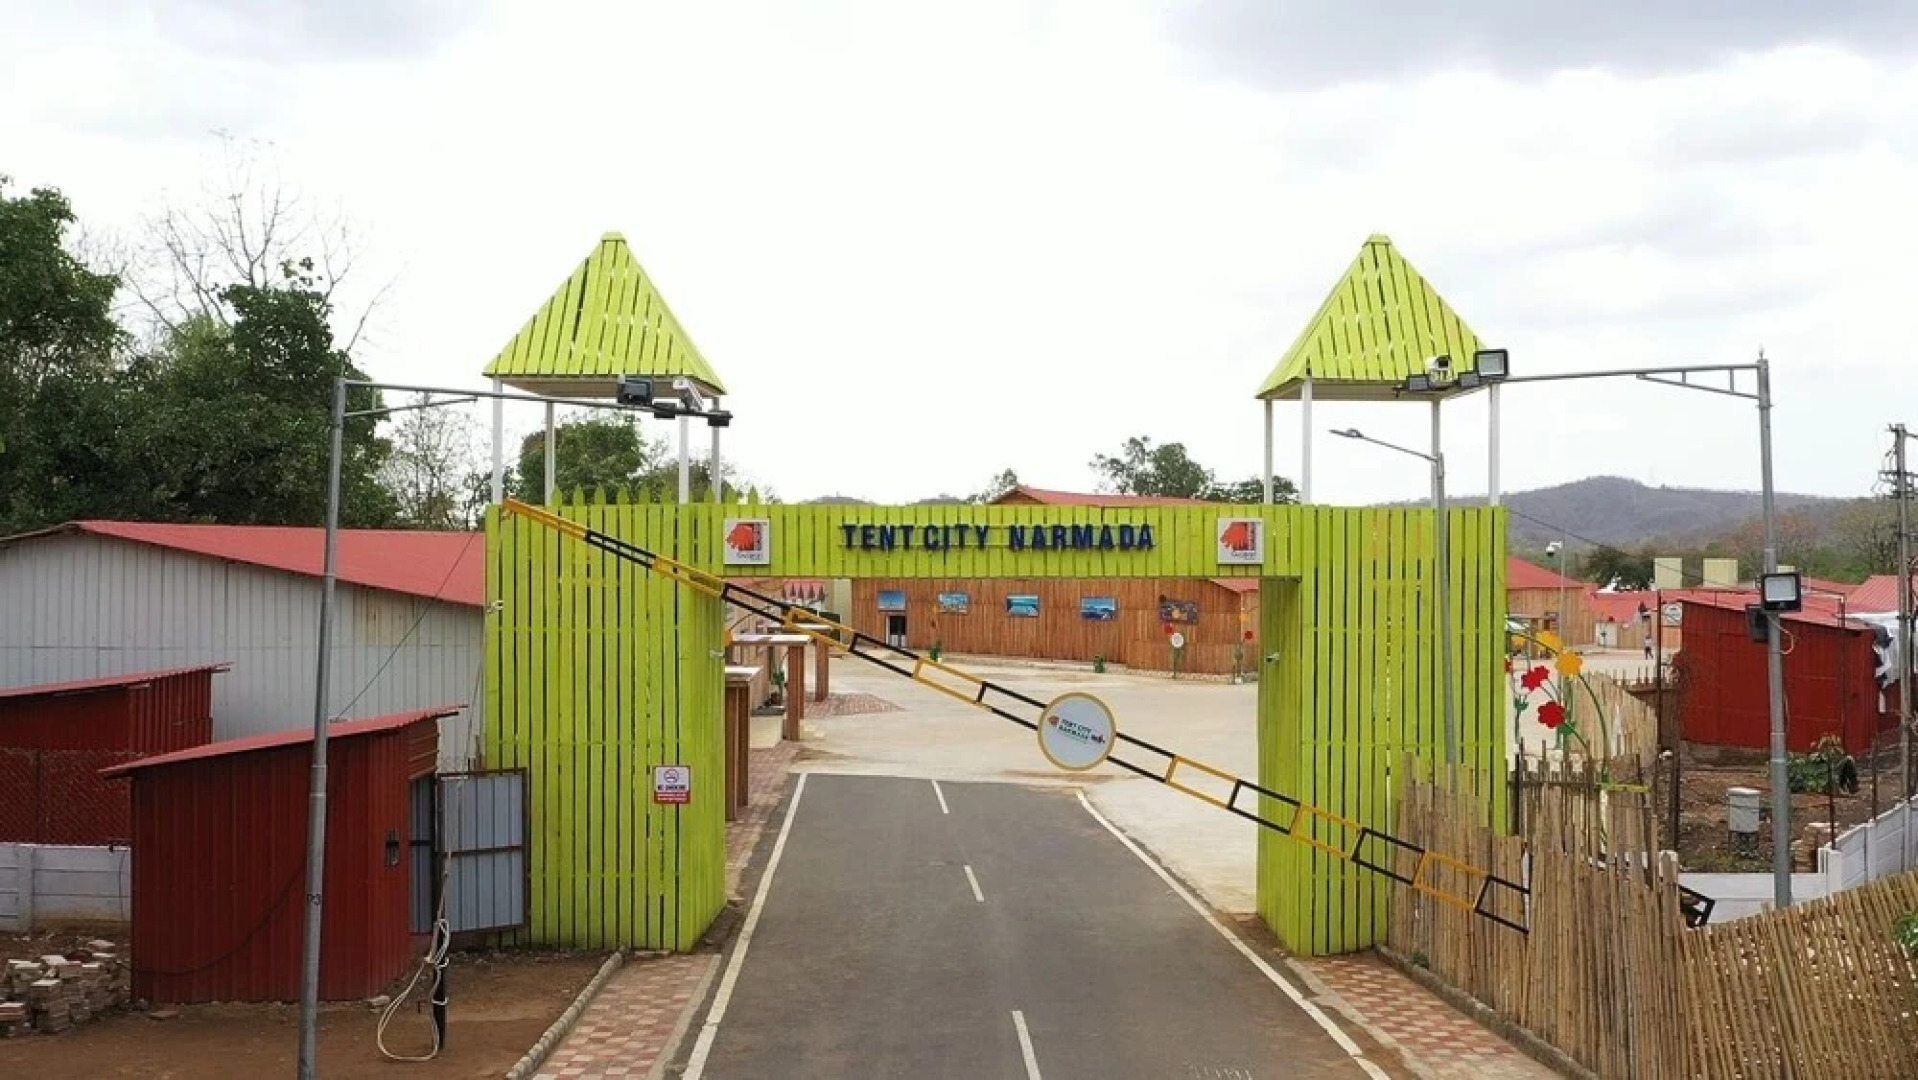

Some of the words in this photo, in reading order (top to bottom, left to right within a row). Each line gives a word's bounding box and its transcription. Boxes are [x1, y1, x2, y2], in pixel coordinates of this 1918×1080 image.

[843, 523, 914, 550] TENT
[923, 523, 989, 550] CITY
[1009, 523, 1154, 550] NARMADA
